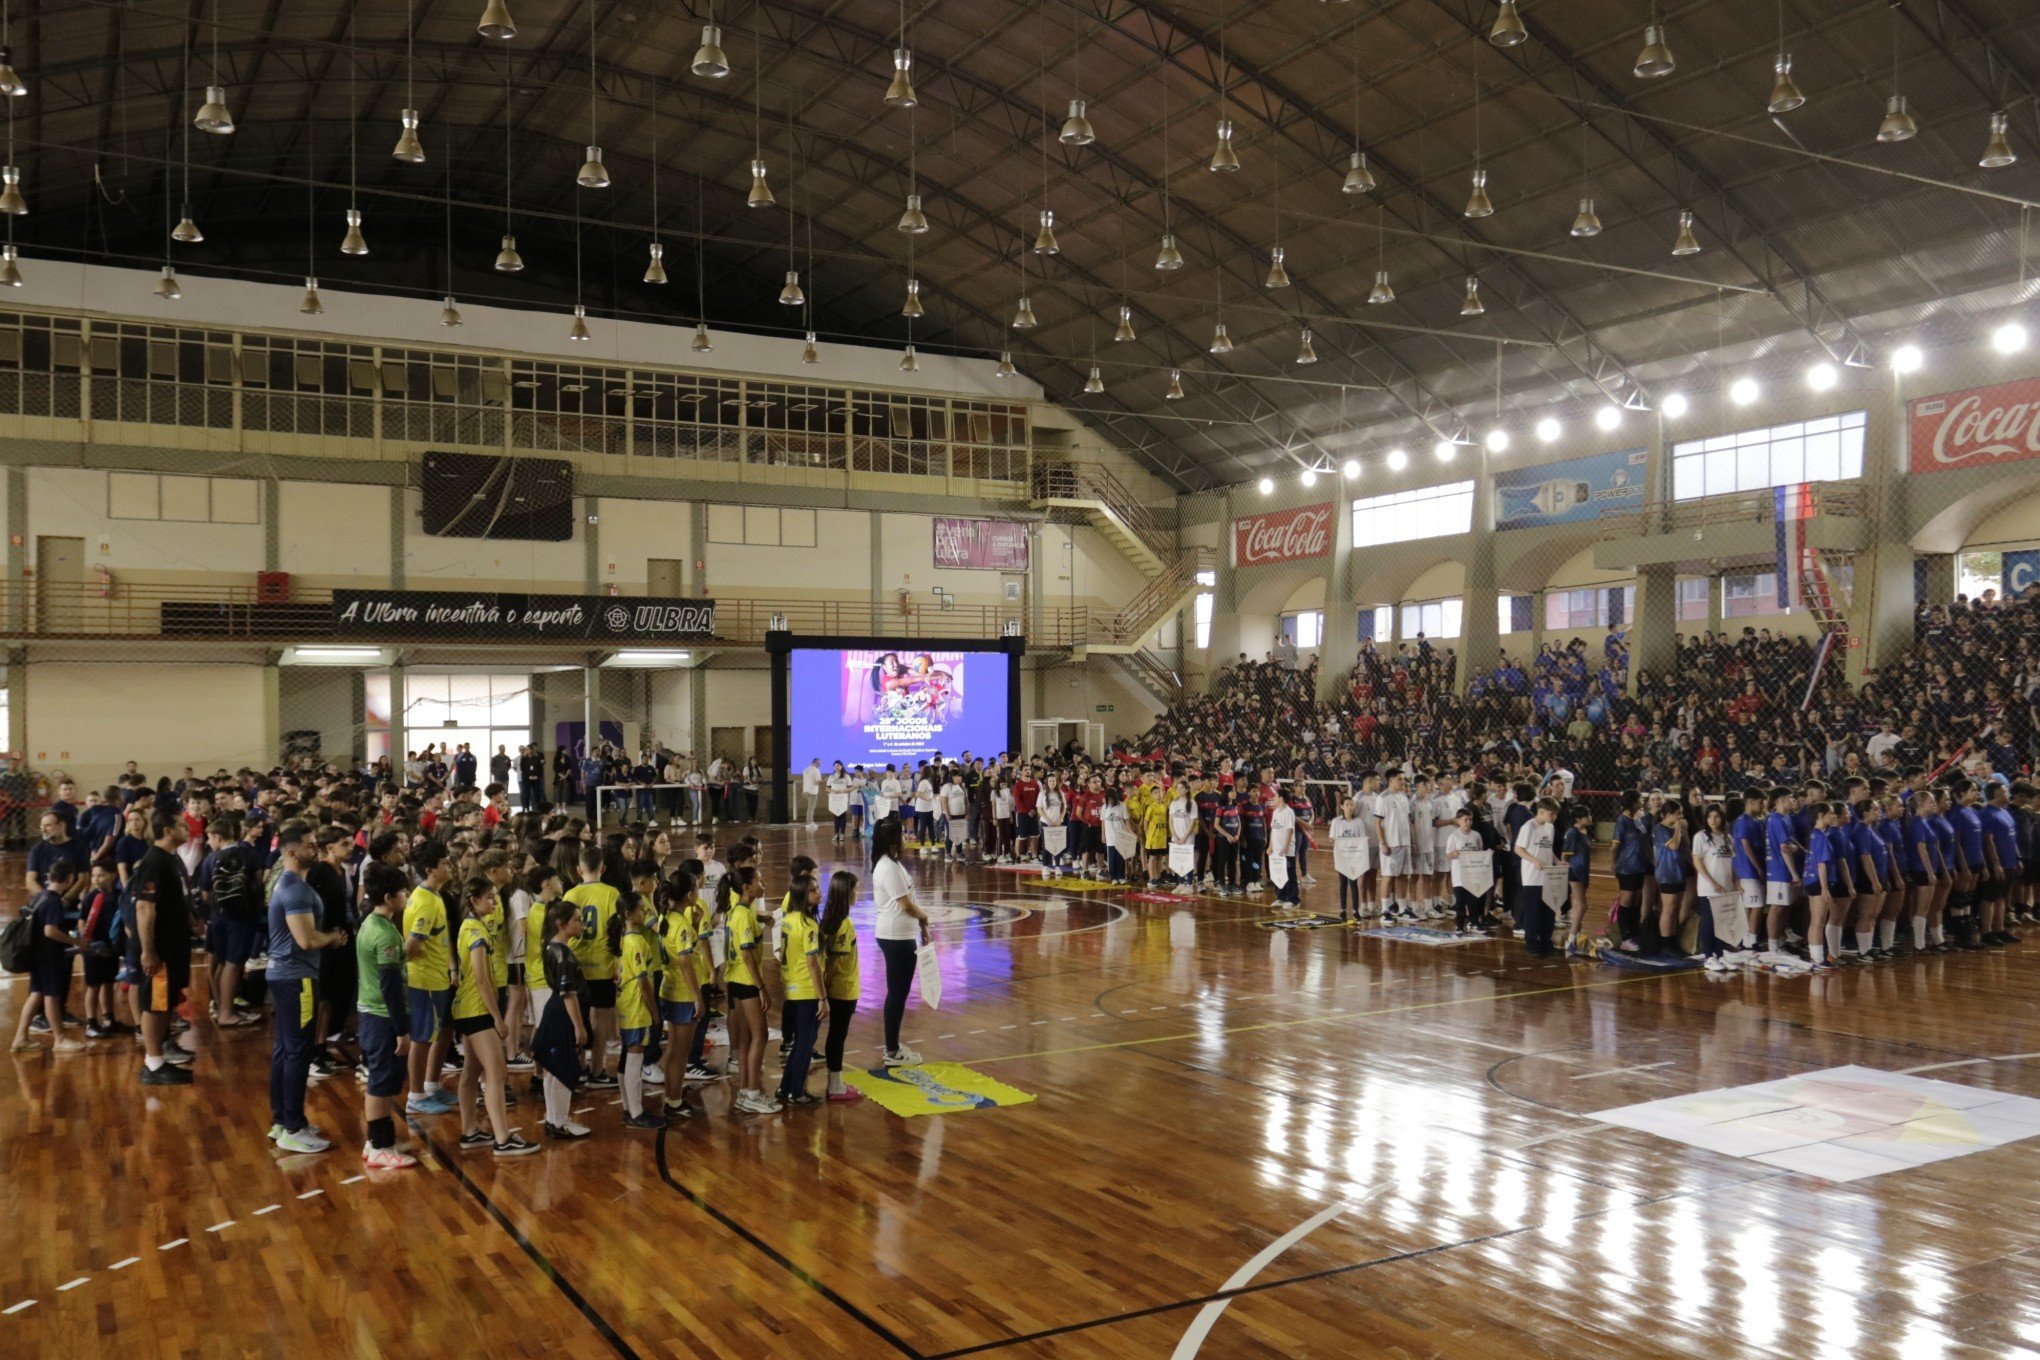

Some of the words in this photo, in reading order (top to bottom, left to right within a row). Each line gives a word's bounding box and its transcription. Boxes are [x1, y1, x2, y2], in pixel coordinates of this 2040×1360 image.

[1246, 509, 1333, 561] Coca-Cola
[340, 601, 359, 623] A
[364, 601, 416, 623] Ulbra
[425, 603, 499, 624] incentiva
[506, 610, 515, 624] o
[523, 603, 583, 631] esporte
[634, 606, 712, 632] ULBRA
